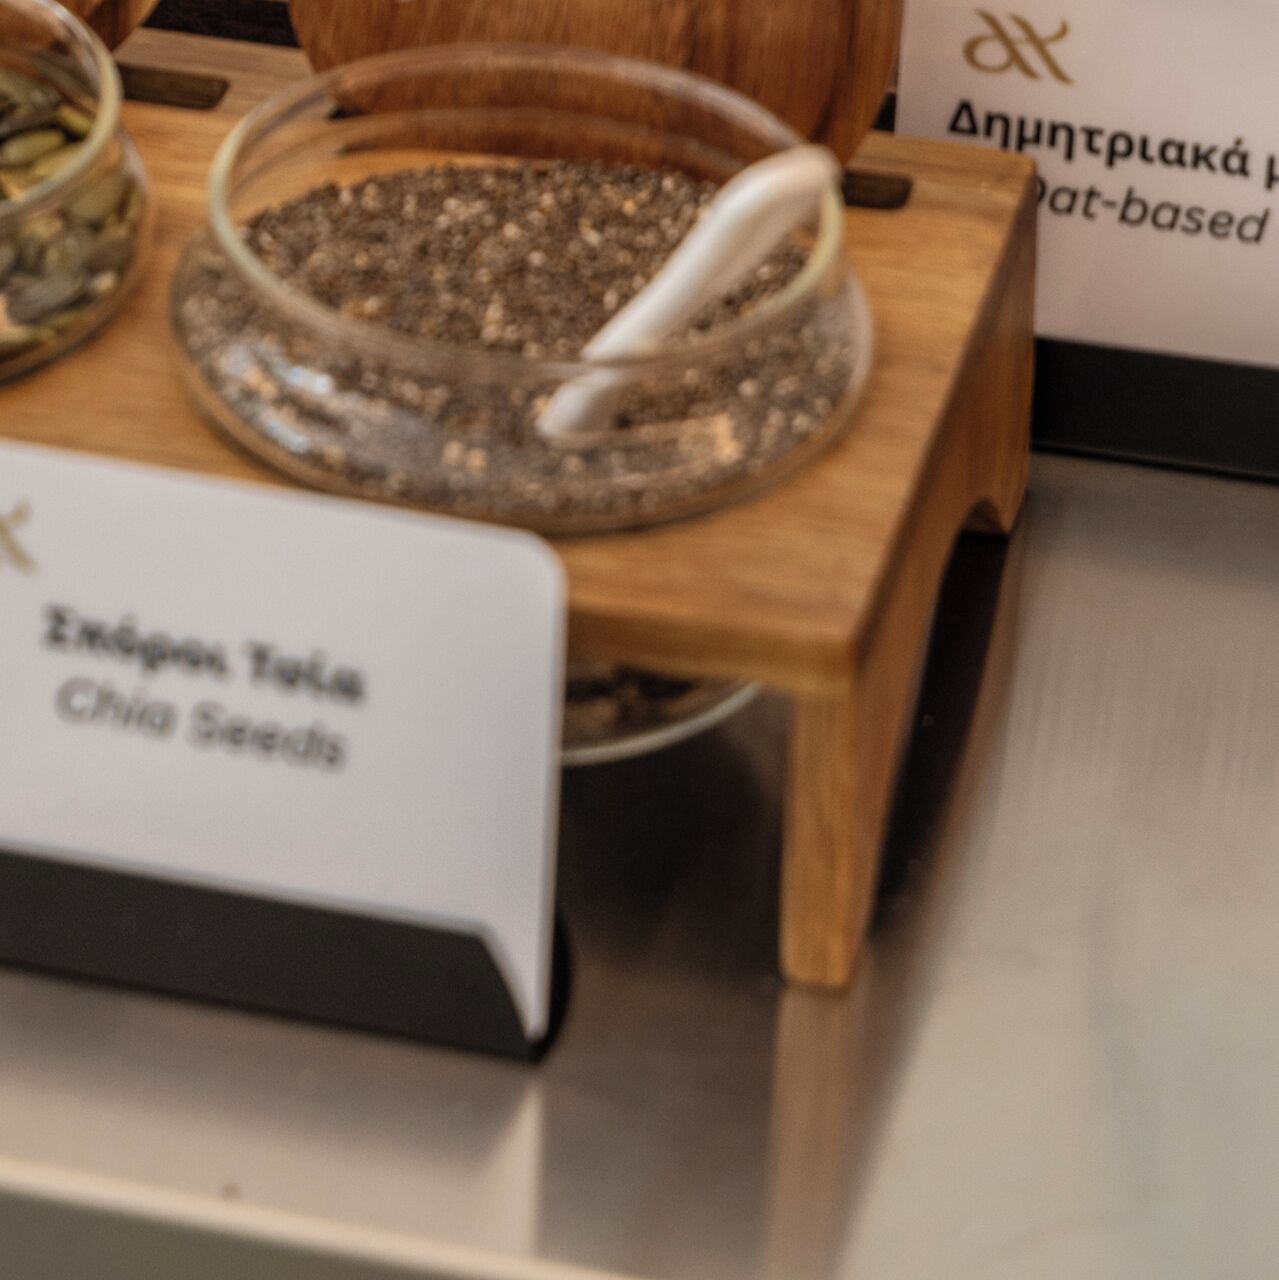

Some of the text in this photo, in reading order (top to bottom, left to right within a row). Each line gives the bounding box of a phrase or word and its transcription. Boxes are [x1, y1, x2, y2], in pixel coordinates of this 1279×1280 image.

[948, 99, 1249, 178] Δημητριακά
[54, 676, 350, 773] Chia Seeds
